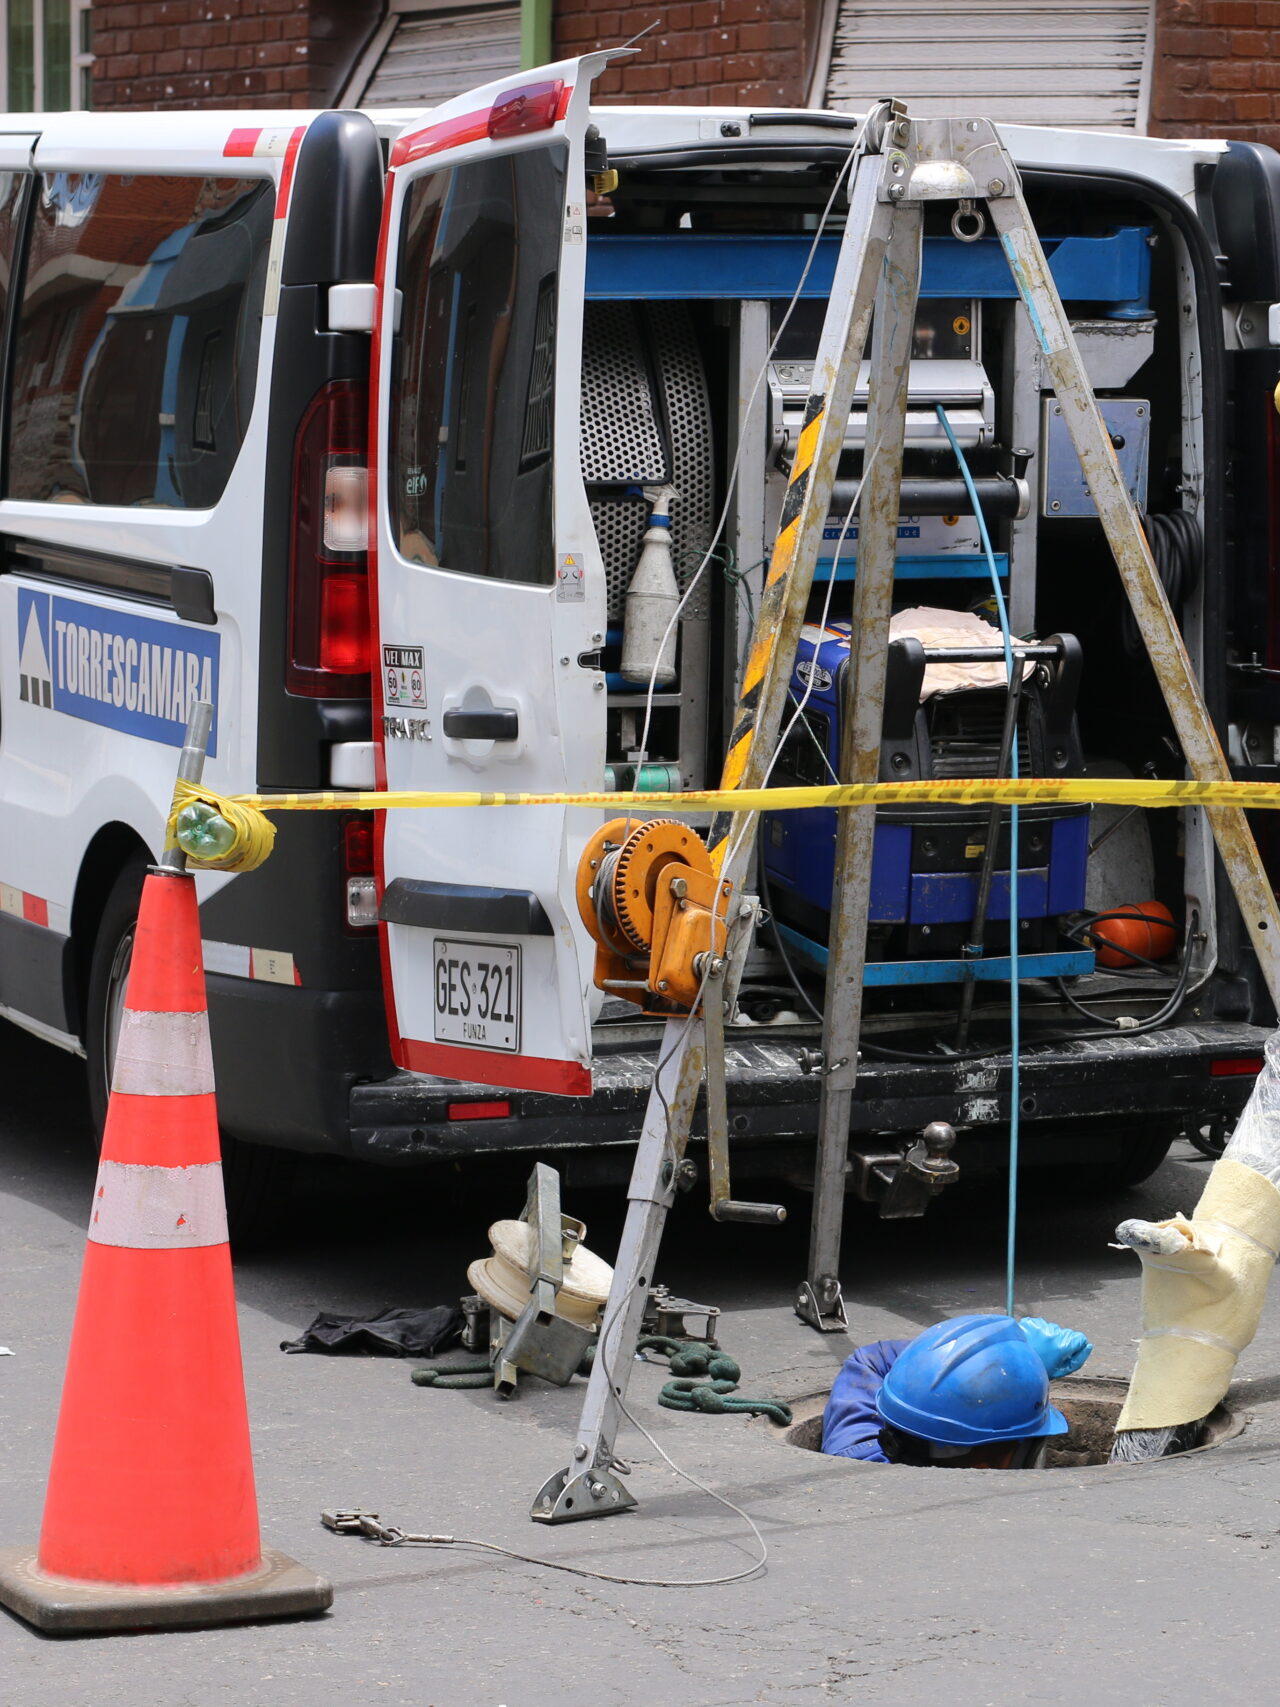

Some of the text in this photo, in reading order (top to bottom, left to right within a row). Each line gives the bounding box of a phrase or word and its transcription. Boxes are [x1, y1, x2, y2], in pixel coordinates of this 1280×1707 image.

[407, 477, 419, 494] elf
[385, 649, 420, 667] VEL MAX
[56, 620, 212, 732] TORRESCAMARA
[388, 677, 397, 688] 50
[411, 679, 421, 690] 80
[436, 958, 514, 1023] GES 321
[463, 1022, 487, 1040] FUNZA
